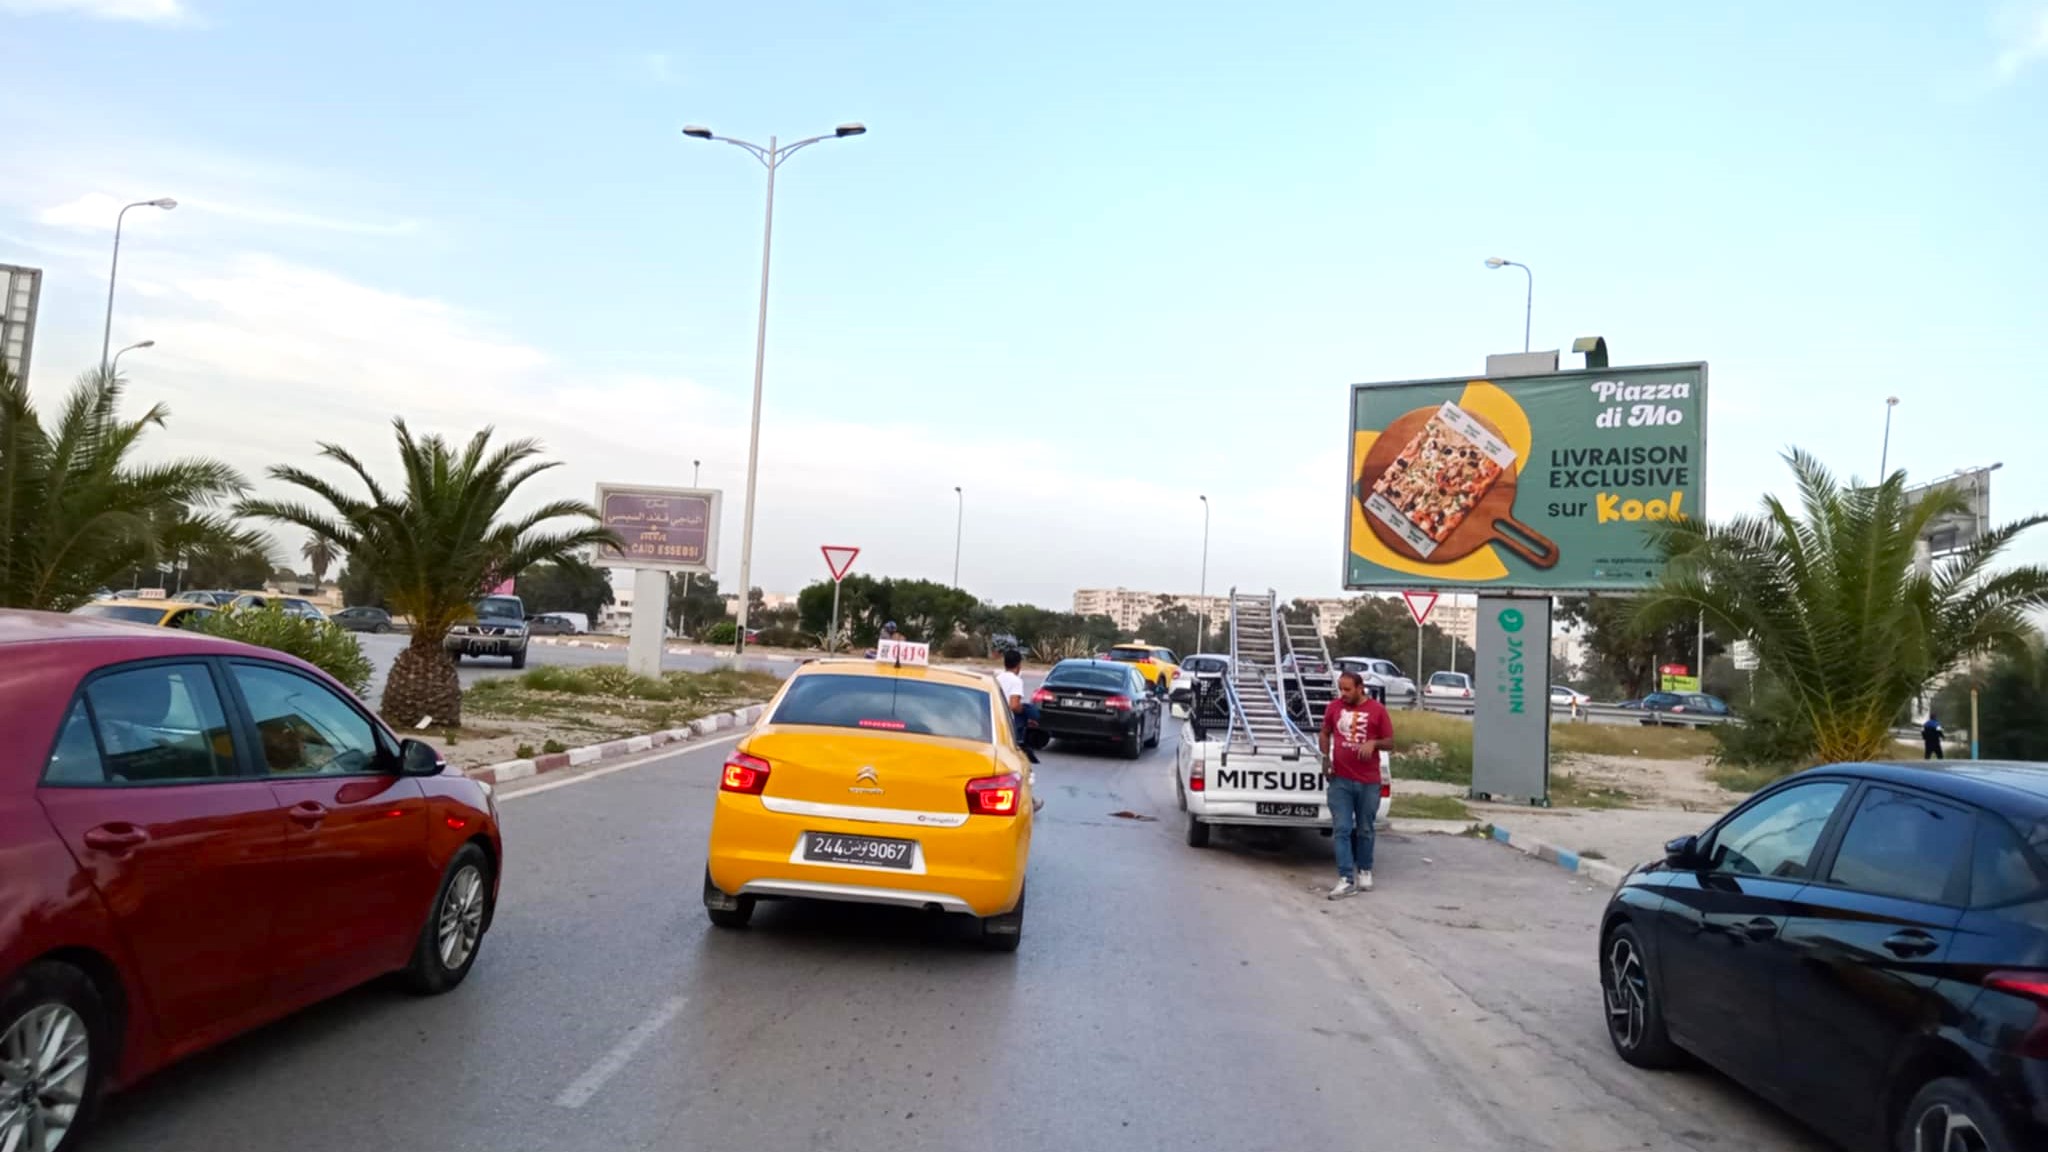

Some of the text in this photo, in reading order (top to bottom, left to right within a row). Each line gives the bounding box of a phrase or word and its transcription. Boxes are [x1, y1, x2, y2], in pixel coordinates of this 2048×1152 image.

[1591, 381, 1690, 402] Piazza
[1596, 404, 1683, 428] di Mo
[1551, 446, 1687, 467] LIVRAISON
[1549, 467, 1688, 488] EXCLUSIVE
[1547, 502, 1588, 517] sur
[813, 838, 843, 856] 244
[868, 842, 907, 860] 9067
